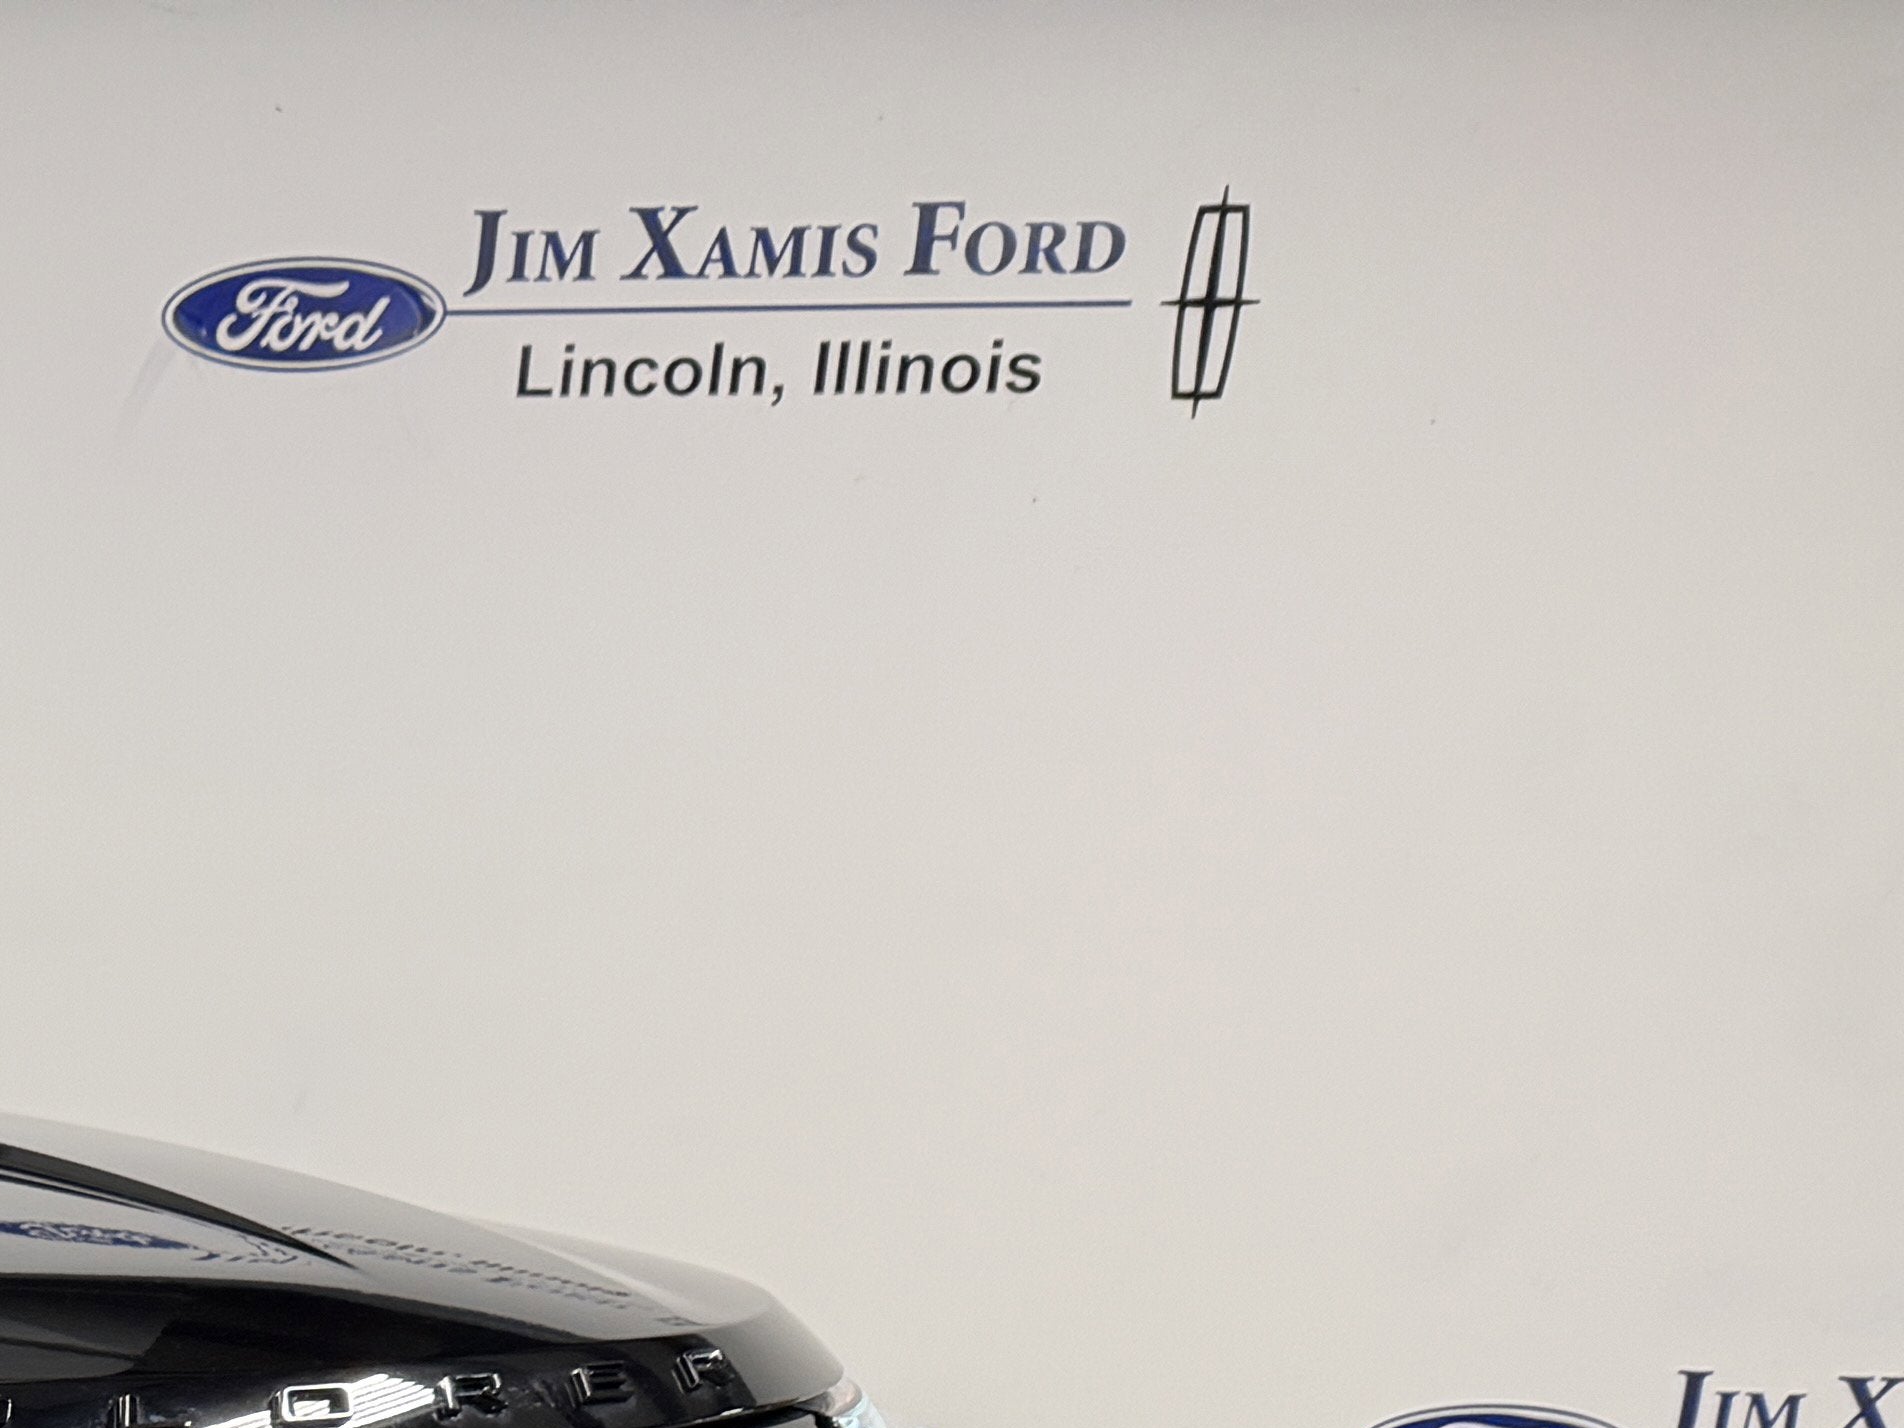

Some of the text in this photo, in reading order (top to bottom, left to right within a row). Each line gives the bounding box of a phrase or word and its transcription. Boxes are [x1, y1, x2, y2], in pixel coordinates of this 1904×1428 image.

[462, 200, 1127, 297] JIM XAMIS FORD
[216, 278, 389, 353] Ford
[516, 338, 1042, 407] Lincoln, Illinois
